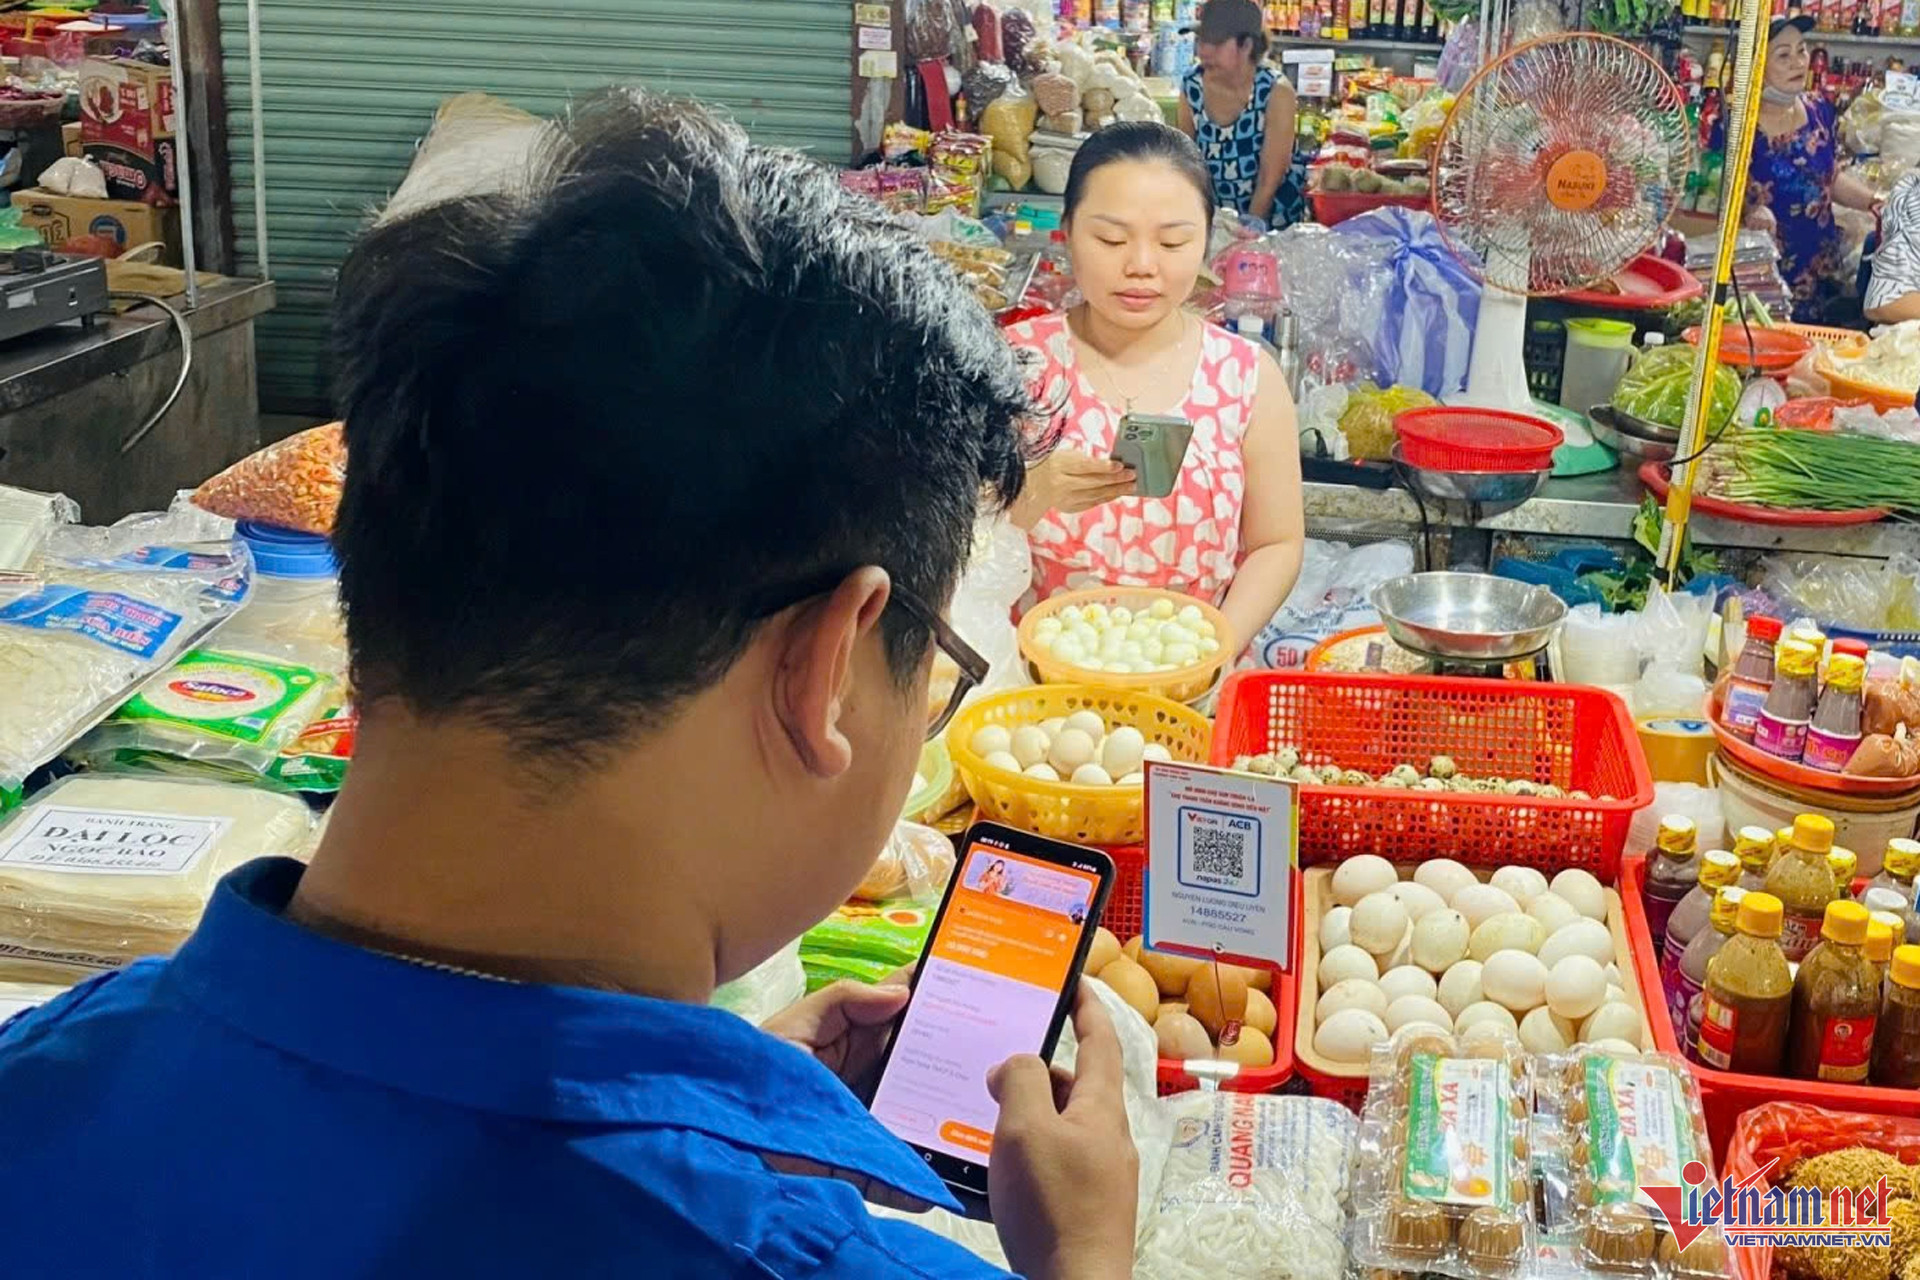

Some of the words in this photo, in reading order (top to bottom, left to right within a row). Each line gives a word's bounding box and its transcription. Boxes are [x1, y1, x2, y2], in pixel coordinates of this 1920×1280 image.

[1277, 646, 1298, 667] 50
[1228, 819, 1252, 830] ACB
[1196, 874, 1222, 885] napas
